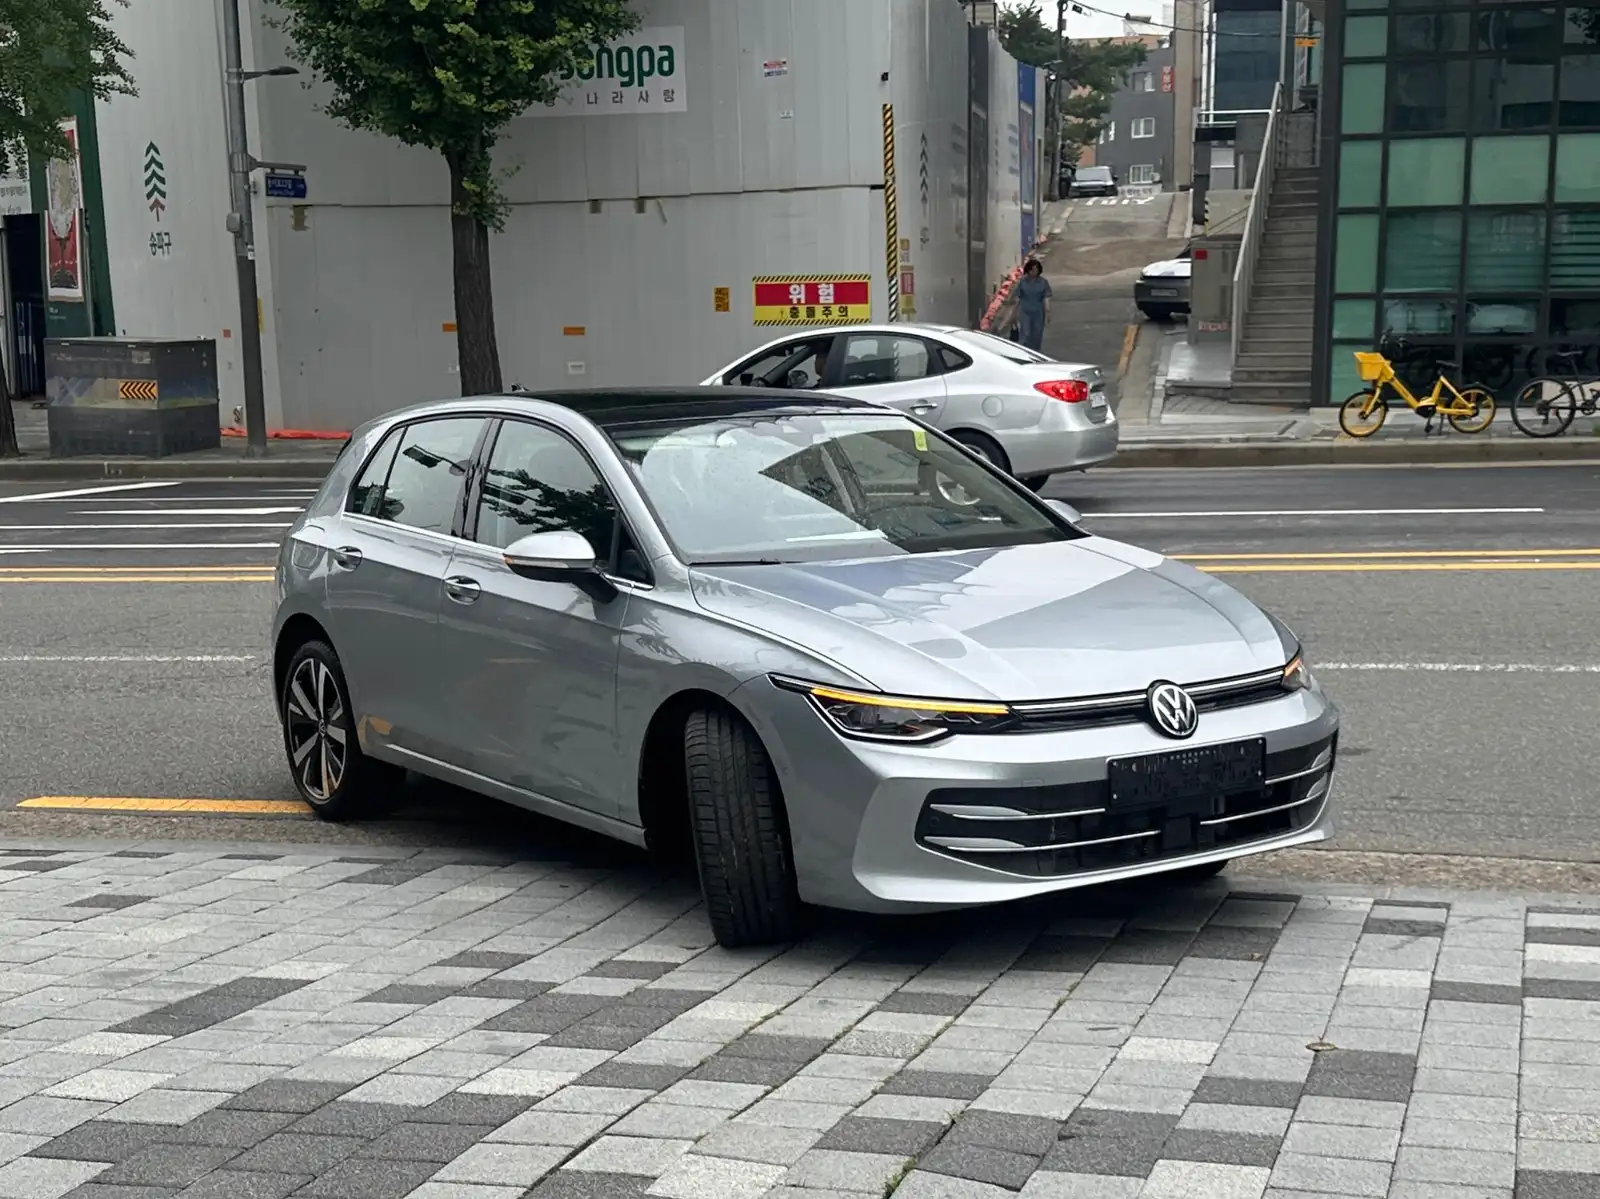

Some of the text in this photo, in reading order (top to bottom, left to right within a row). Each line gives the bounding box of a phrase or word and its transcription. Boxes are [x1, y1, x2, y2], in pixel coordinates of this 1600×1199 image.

[149, 231, 172, 257] 송파구
[788, 283, 835, 304] 위험
[789, 306, 849, 319] 충돌주의
